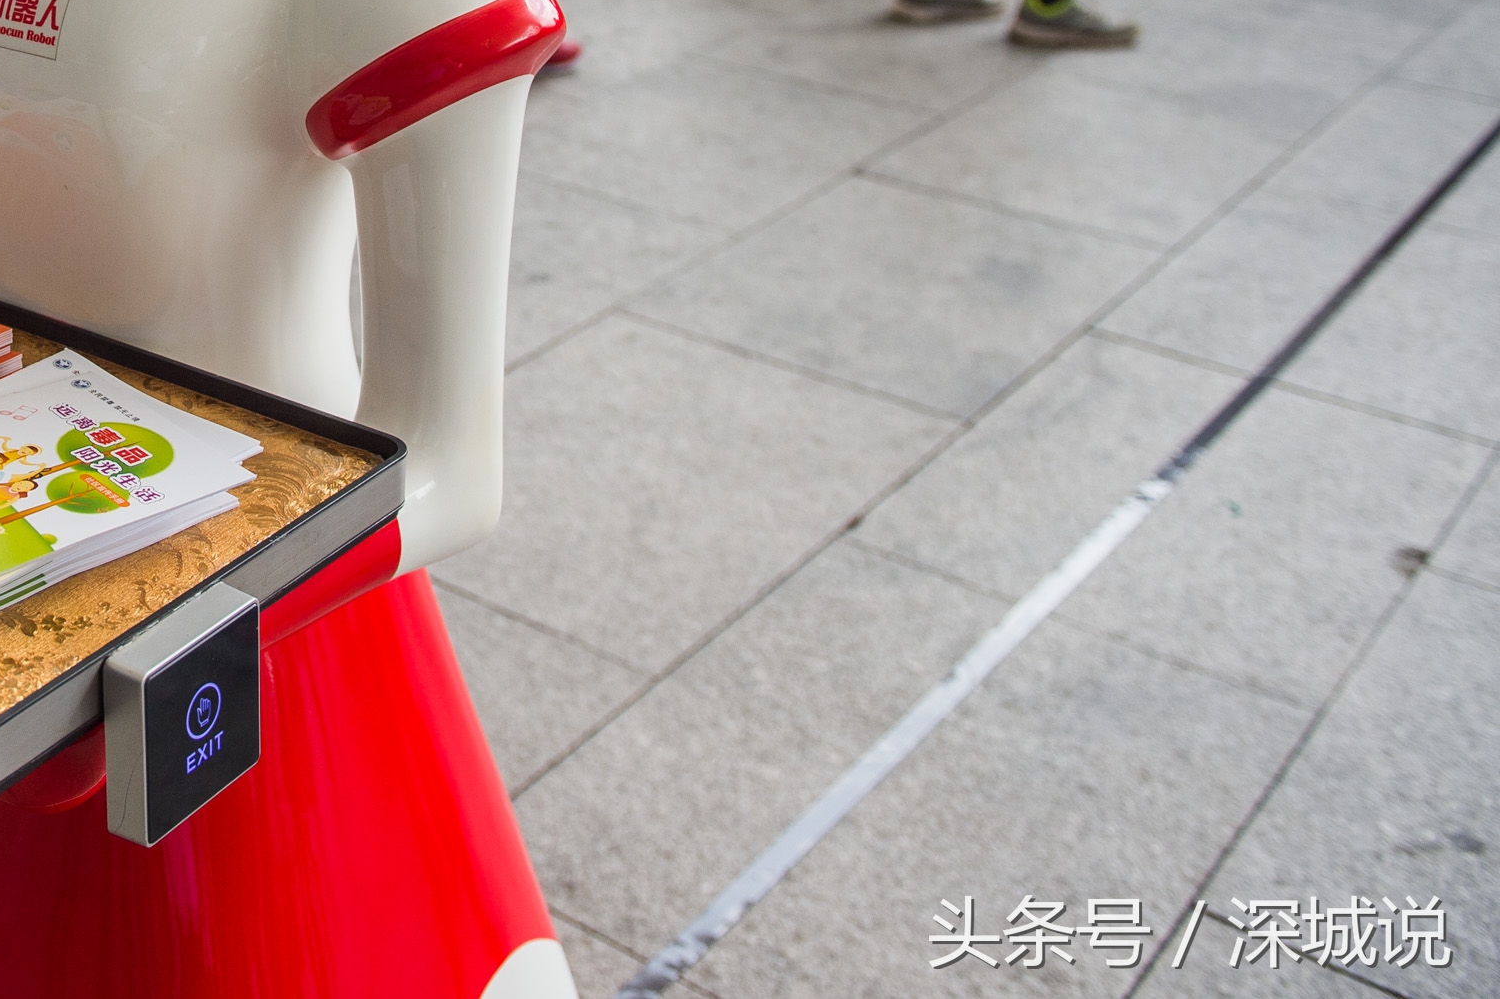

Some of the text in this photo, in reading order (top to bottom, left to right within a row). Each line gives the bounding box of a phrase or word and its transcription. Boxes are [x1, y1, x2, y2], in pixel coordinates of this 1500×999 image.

[27, 29, 56, 47] Robot
[52, 402, 151, 466] 远离毒品
[73, 446, 162, 503] 阳光生活
[186, 730, 225, 775] EXIT
